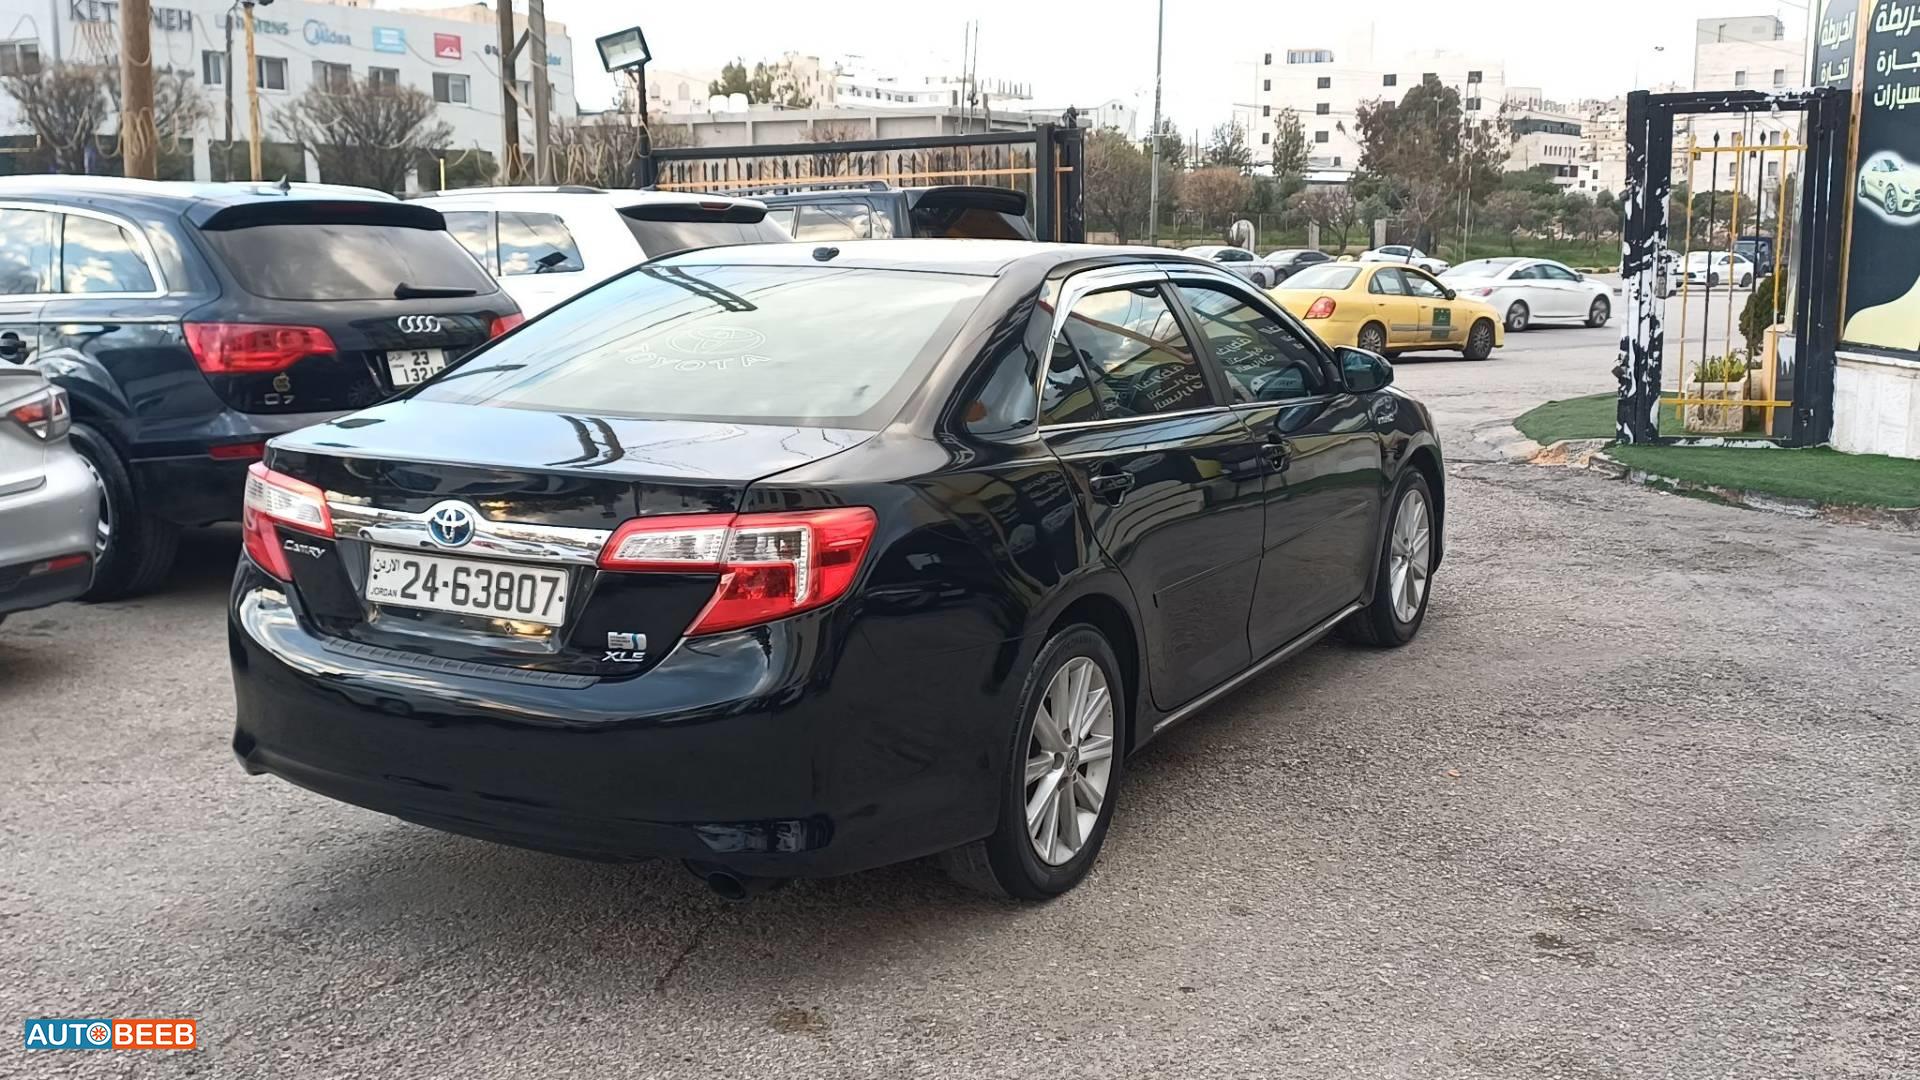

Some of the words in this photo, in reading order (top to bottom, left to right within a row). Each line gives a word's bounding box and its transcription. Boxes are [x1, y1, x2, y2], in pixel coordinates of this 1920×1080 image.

[69, 0, 192, 31] KETNEH
[1821, 11, 1856, 49] الخريطة
[1875, 2, 1920, 36] ريطة
[1820, 57, 1850, 87] لتجارة
[412, 351, 430, 366] 23
[370, 587, 398, 598] JORDAN
[400, 560, 560, 616] 24-63807
[601, 651, 646, 662] XLE
